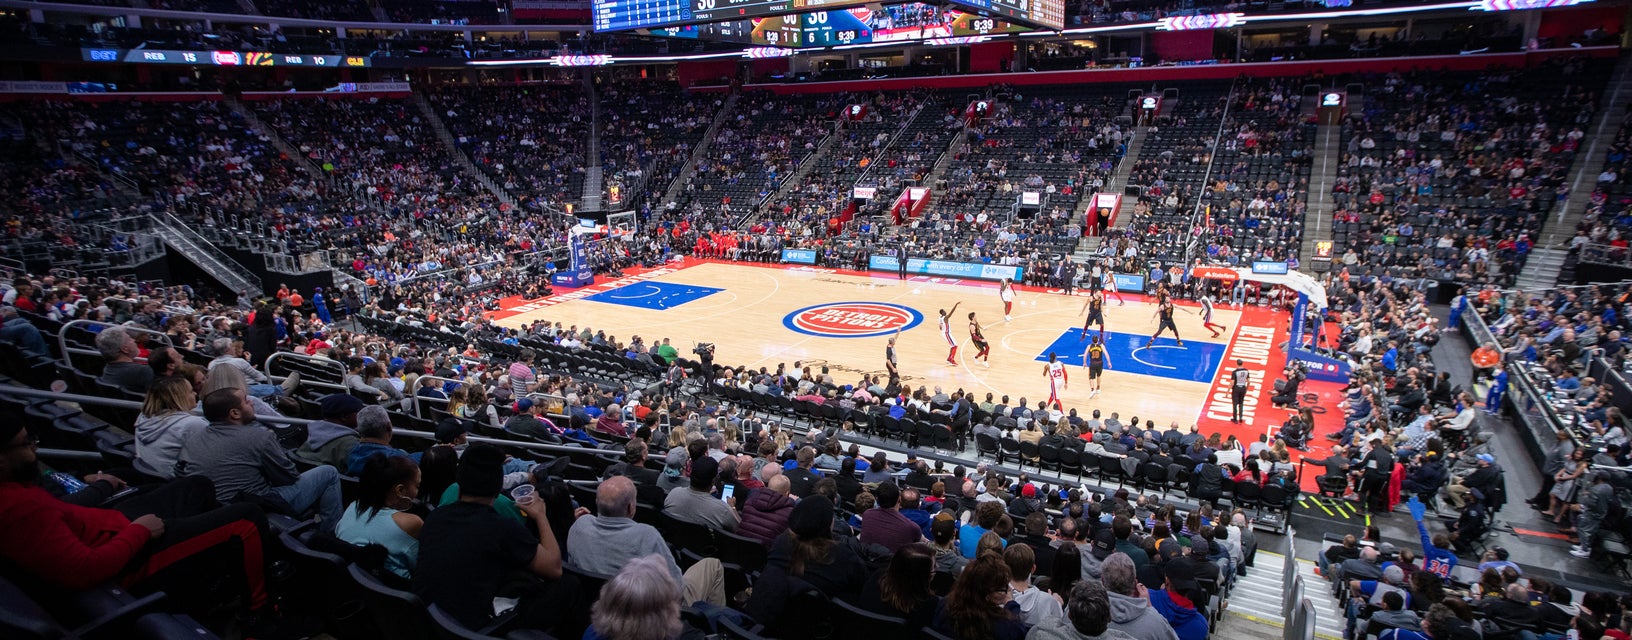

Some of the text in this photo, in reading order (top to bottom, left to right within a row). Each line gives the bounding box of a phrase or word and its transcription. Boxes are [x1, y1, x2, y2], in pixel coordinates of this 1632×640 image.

[973, 19, 993, 31] 9:39
[784, 32, 798, 43] 1 6
[809, 32, 829, 43] 6 1
[838, 31, 855, 41] 9:39
[143, 51, 197, 62] REB 15
[285, 55, 325, 65] REB 10
[940, 264, 955, 272] every
[598, 266, 679, 288] PISTONS
[506, 288, 599, 312] DETROIT
[809, 313, 886, 328] PISTONS
[822, 309, 899, 322] DETROIT
[1229, 325, 1275, 366] DETROIT
[1052, 369, 1062, 378] 25
[1429, 559, 1450, 578] 34
